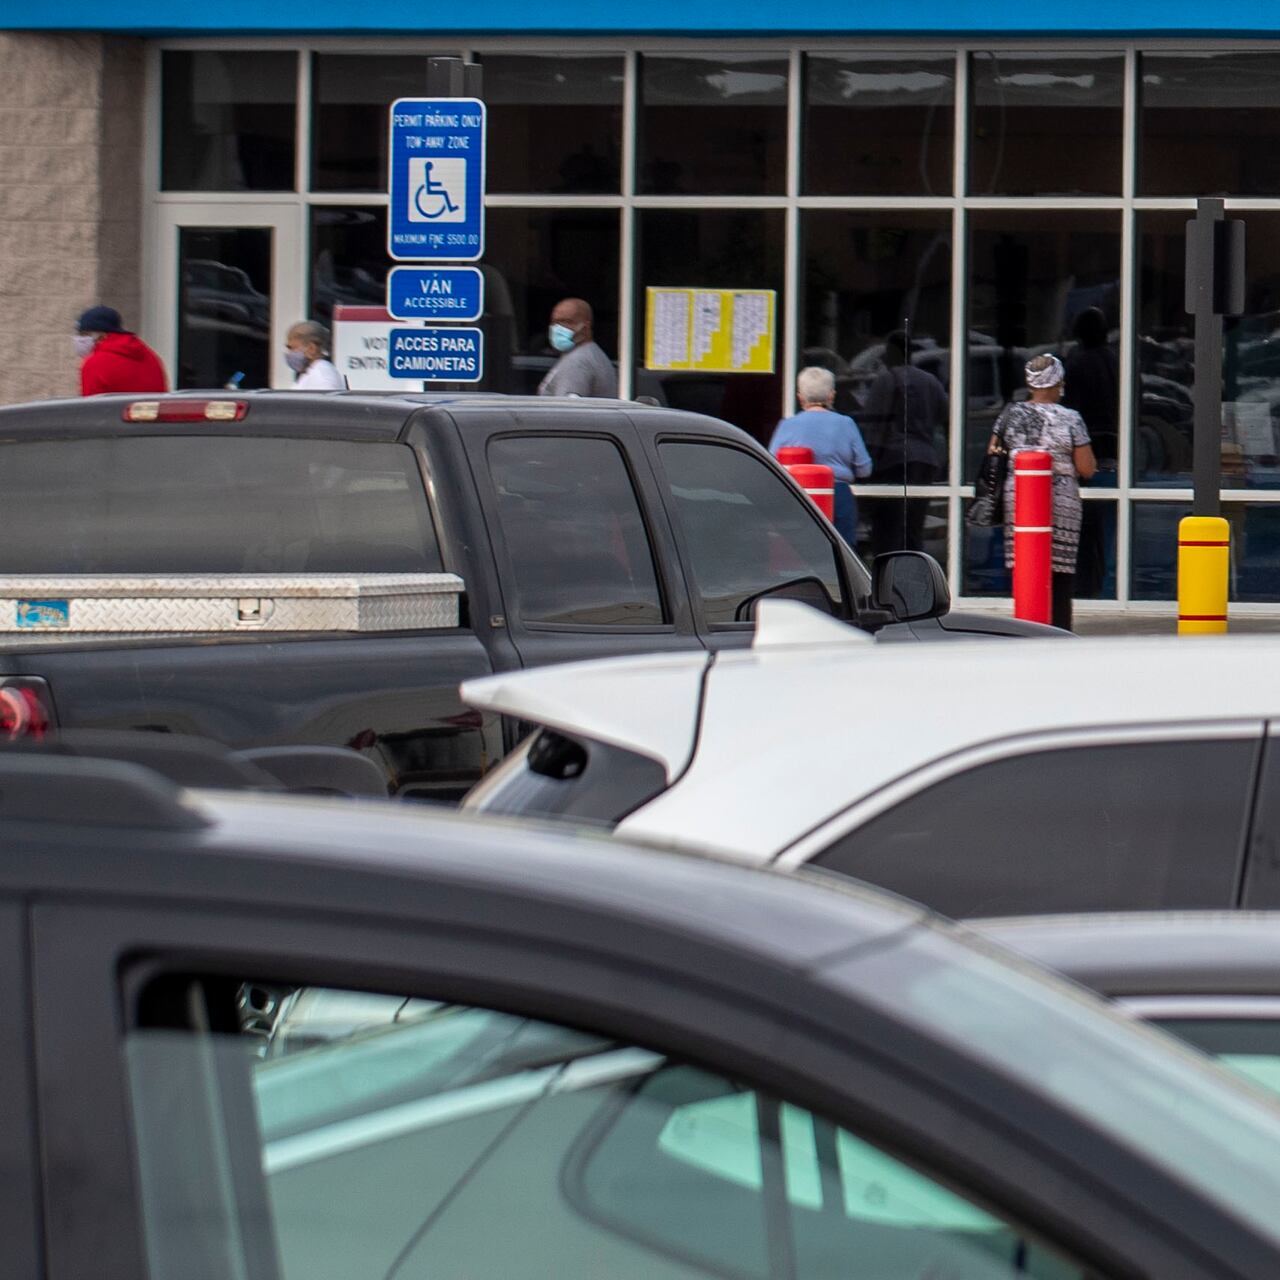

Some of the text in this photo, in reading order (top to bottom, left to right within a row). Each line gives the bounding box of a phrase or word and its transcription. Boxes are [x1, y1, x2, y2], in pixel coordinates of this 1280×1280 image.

[394, 115, 482, 127] PERMIT PARKING ONLY
[447, 136, 469, 149] ZONE
[429, 234, 445, 244] FINE
[420, 279, 452, 294] VAN
[403, 297, 467, 309] ACCESSIBLE
[395, 336, 476, 352] ACCES PARA
[394, 356, 476, 371] CAMIONETAS
